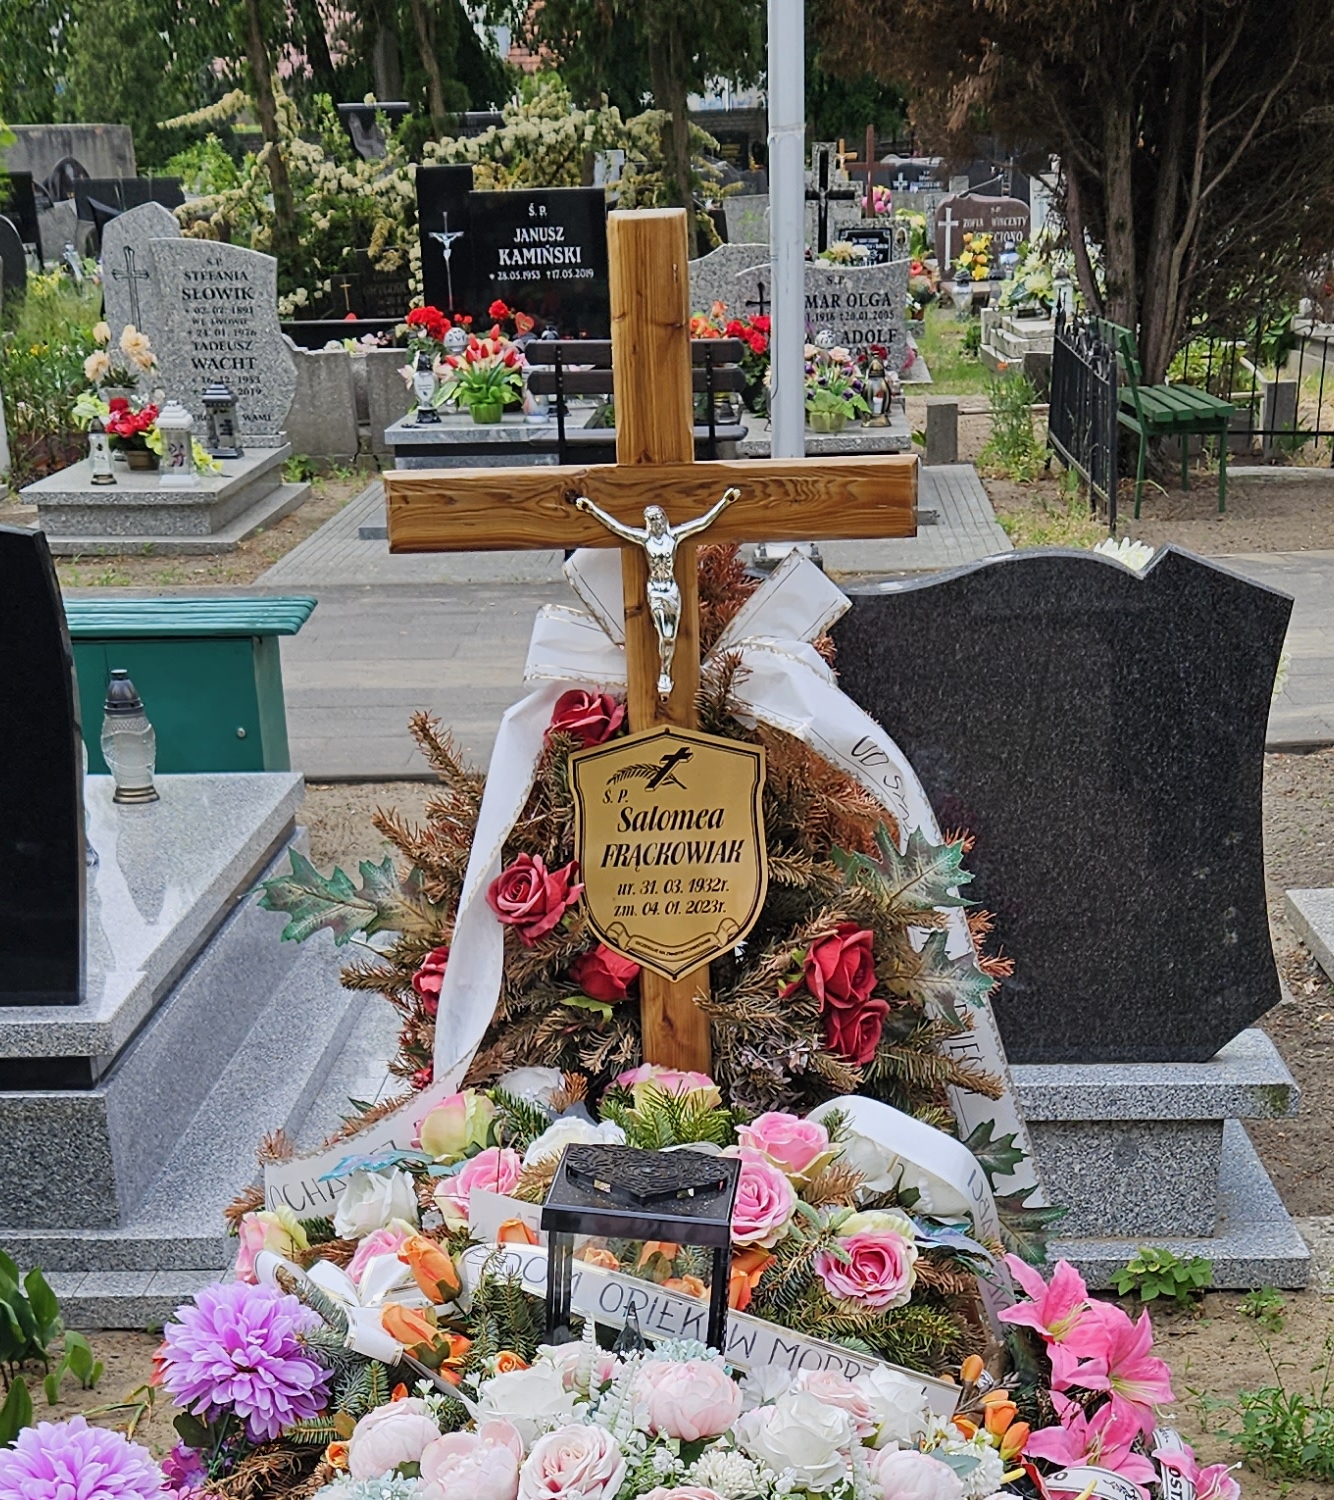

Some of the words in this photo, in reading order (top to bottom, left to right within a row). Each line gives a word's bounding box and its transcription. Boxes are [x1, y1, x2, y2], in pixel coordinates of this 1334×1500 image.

[963, 218, 984, 228] ZOFIA
[991, 215, 1028, 227] WINCENTY
[513, 226, 565, 243] JANUSZ
[498, 245, 582, 266] KAMIŃSKI
[184, 270, 250, 282] STEFANIA
[182, 286, 255, 301] SŁOWIK
[845, 292, 892, 308] OLGA
[840, 329, 897, 345] ADOLF
[192, 340, 254, 352] TADEUSZ
[191, 356, 258, 371] WACHT
[241, 413, 272, 422] WAMI
[618, 788, 629, 804] P.
[617, 806, 725, 833] Salomea
[601, 840, 745, 872] FRĄCKOWIAK
[618, 883, 637, 896] ur.
[640, 880, 659, 895] 31.
[663, 879, 684, 895] 03.
[688, 878, 730, 894] 1932r.
[614, 905, 638, 917] zm.
[642, 902, 661, 917] 04.
[665, 901, 682, 916] 01.
[685, 898, 727, 915] 2023r.
[726, 1323, 758, 1359] W
